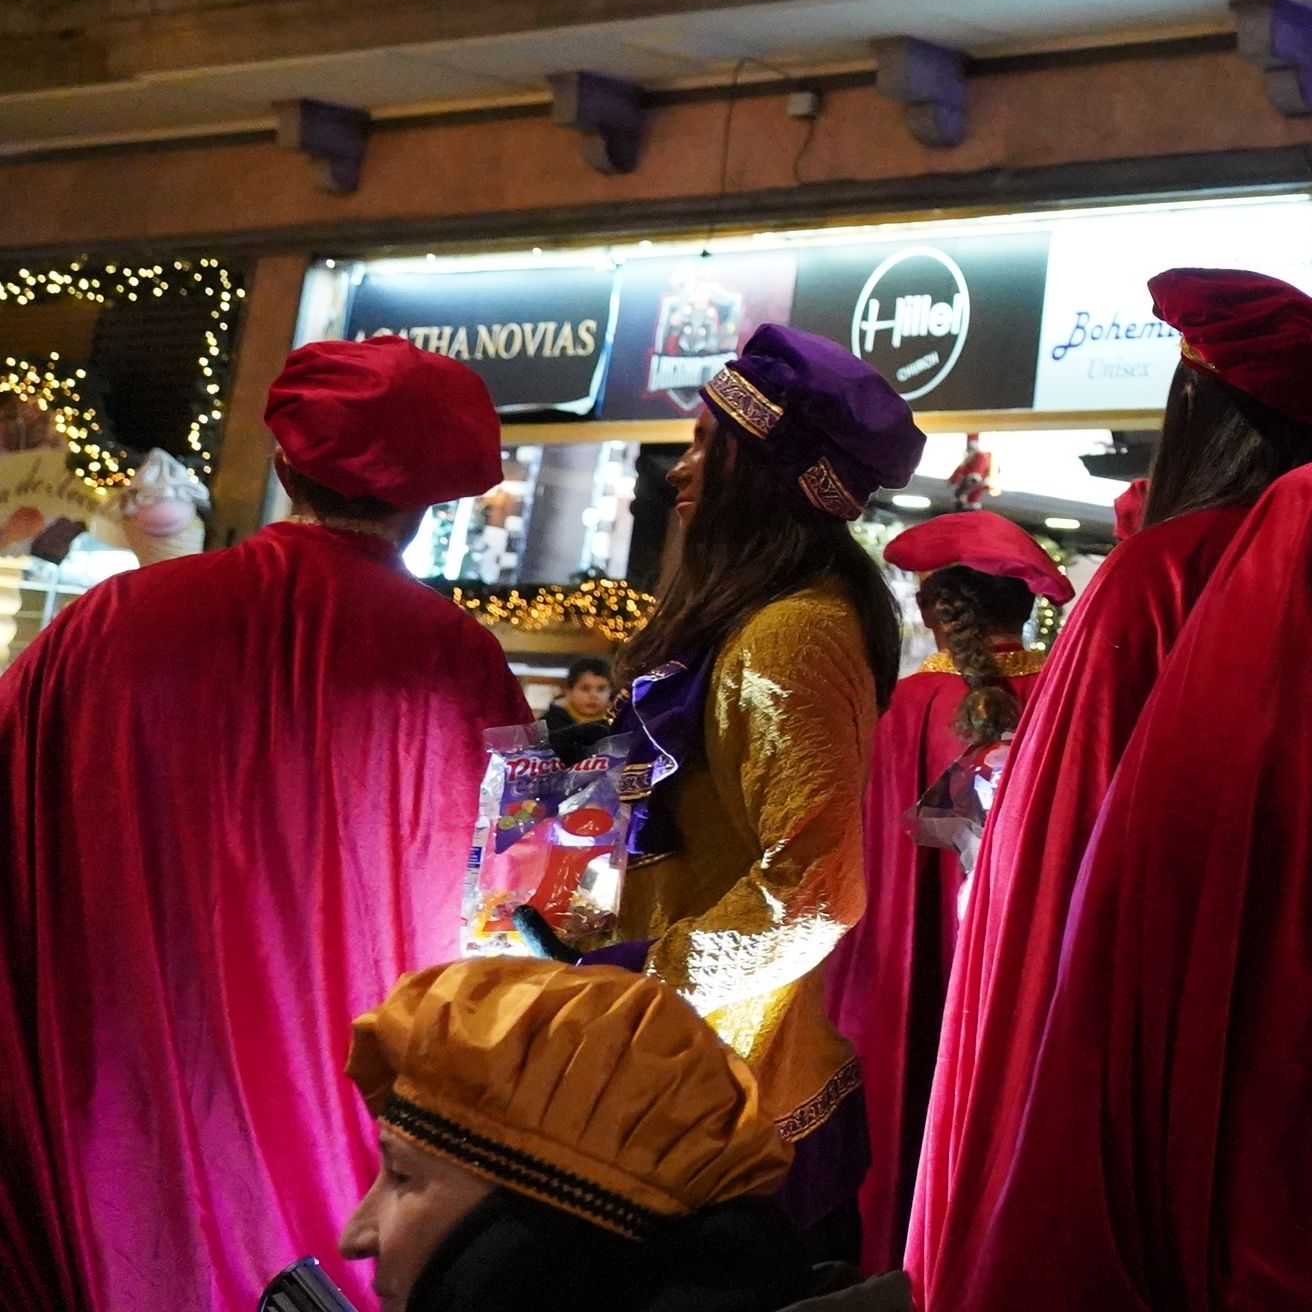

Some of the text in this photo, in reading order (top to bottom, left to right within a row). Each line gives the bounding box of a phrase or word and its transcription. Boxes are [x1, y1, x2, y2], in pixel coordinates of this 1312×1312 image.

[473, 318, 598, 360] NOVIAS
[860, 292, 963, 353] Hillel
[1051, 310, 1184, 361] Bohemi
[1087, 356, 1152, 380] Unisex
